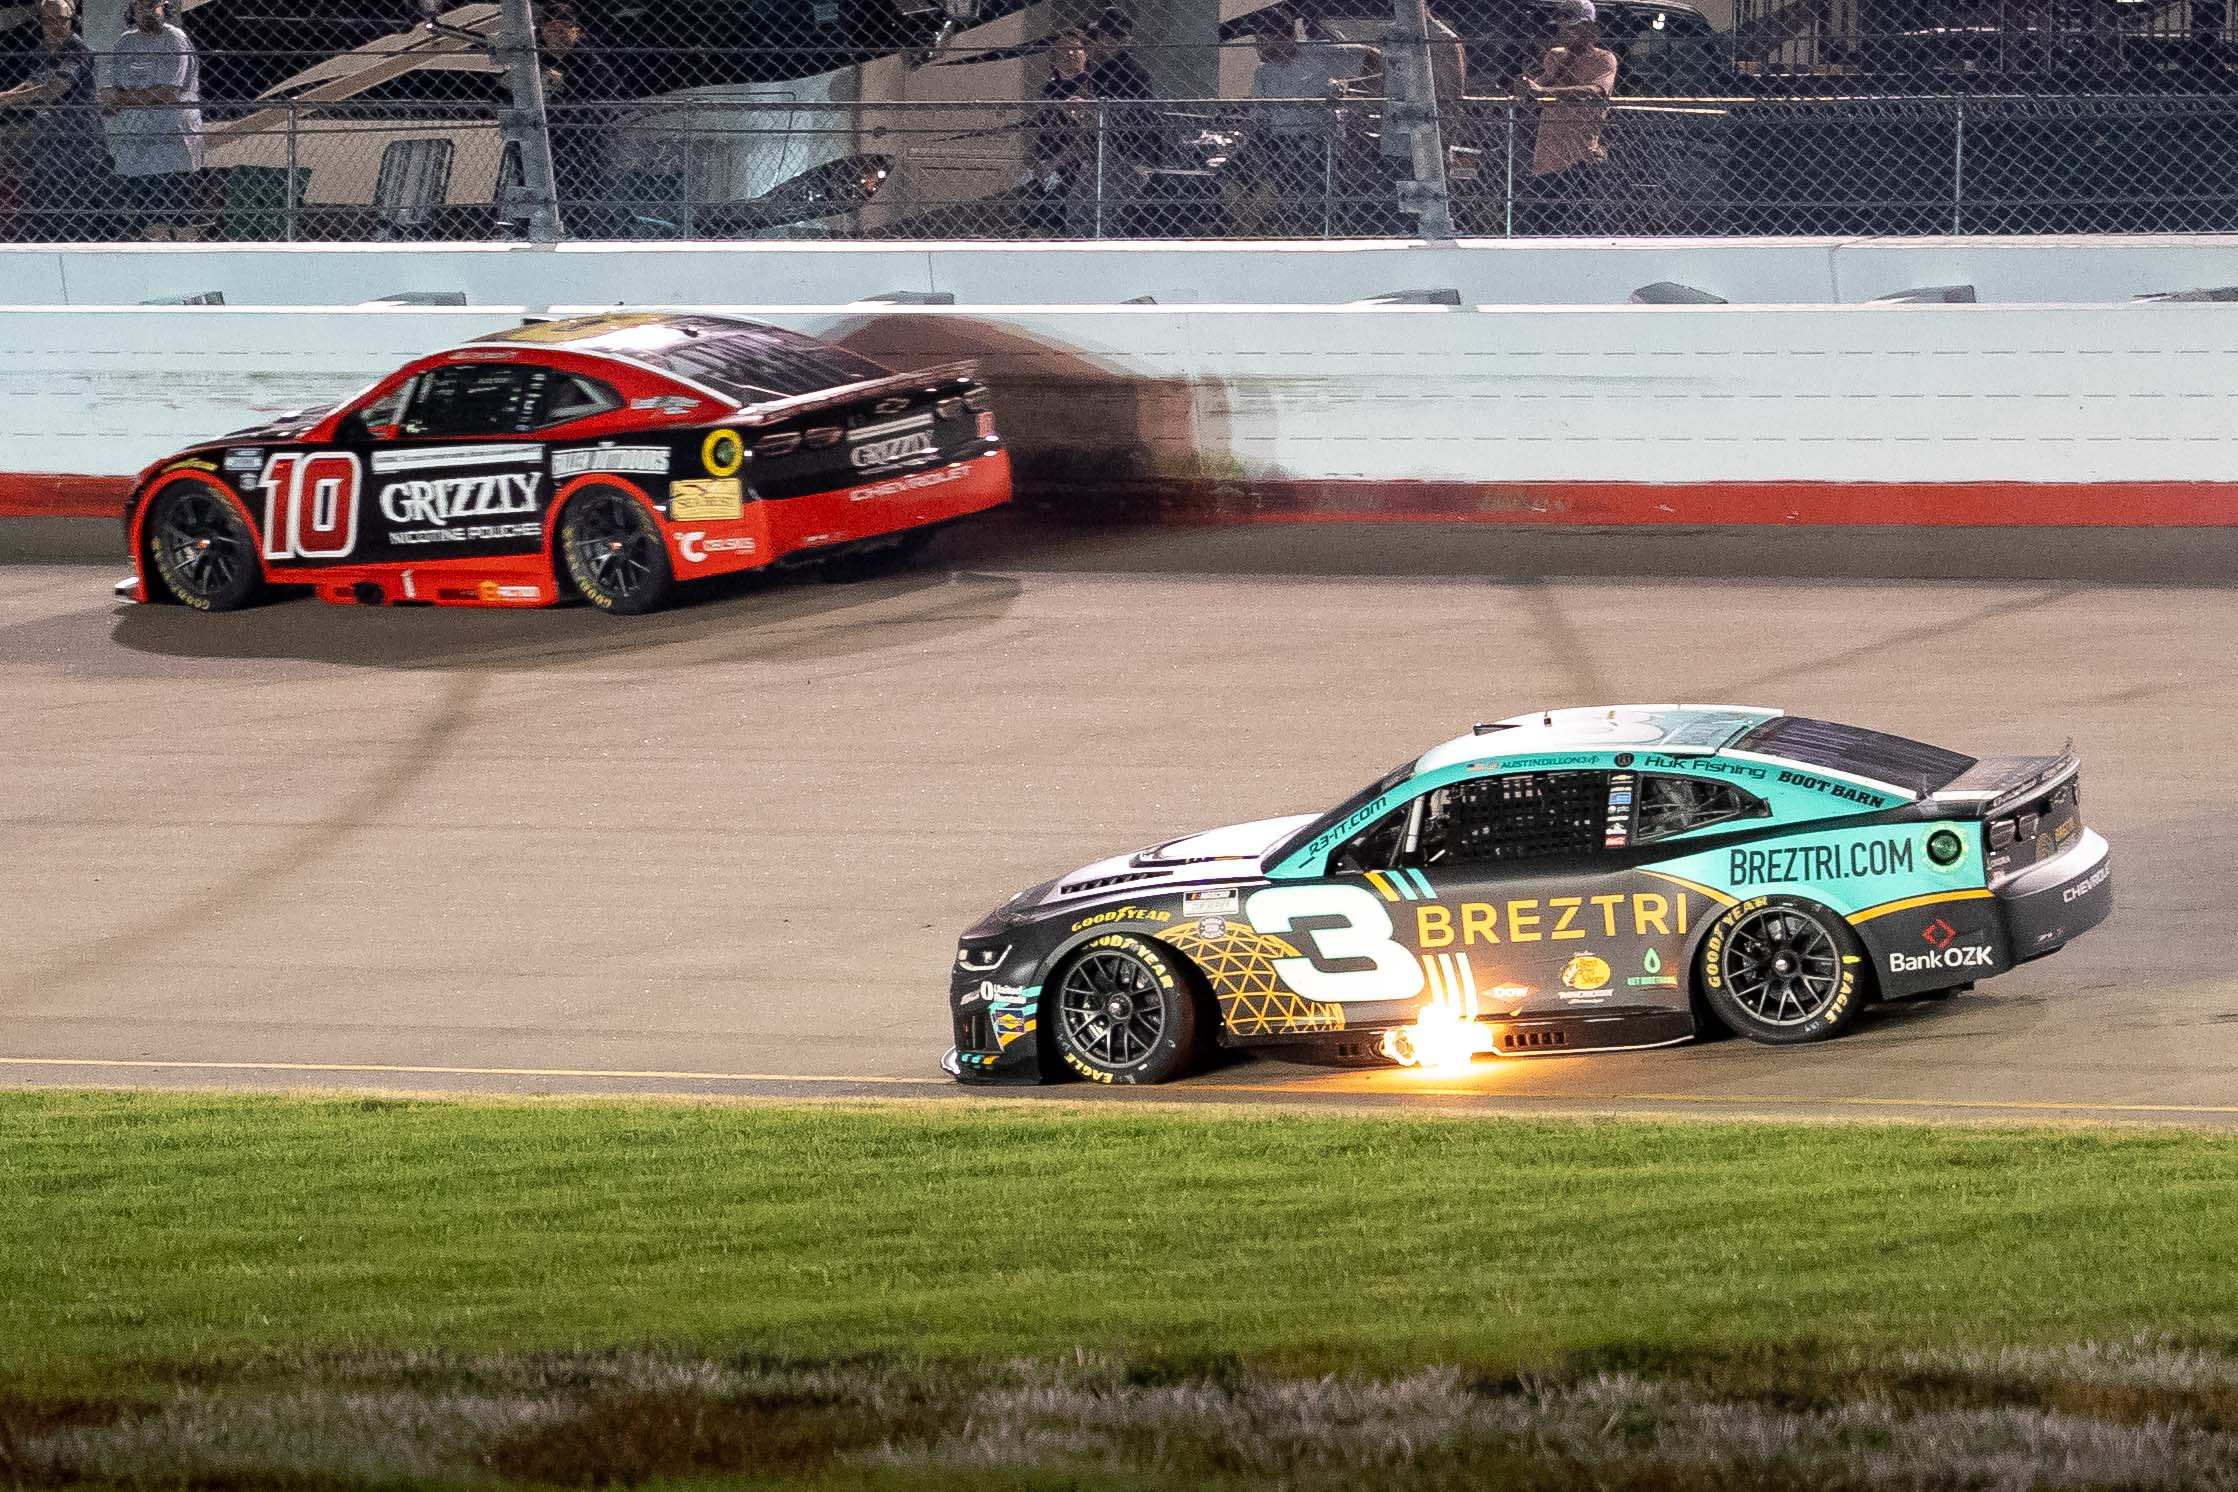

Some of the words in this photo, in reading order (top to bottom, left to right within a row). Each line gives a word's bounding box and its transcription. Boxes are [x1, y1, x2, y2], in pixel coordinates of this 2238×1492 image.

[258, 452, 363, 560] 10
[379, 472, 544, 526] GRIZZLY
[1777, 770, 1832, 792] BOOT
[1831, 783, 1886, 809] BARN
[1730, 838, 1915, 886] BREZTRI.COM
[1071, 905, 1171, 932] GOODYEAR
[1245, 884, 1425, 1003] 3
[1416, 892, 1687, 948] BREZTRI
[1825, 971, 1855, 1024] EAGLE
[1064, 1052, 1114, 1084] EAGLE
